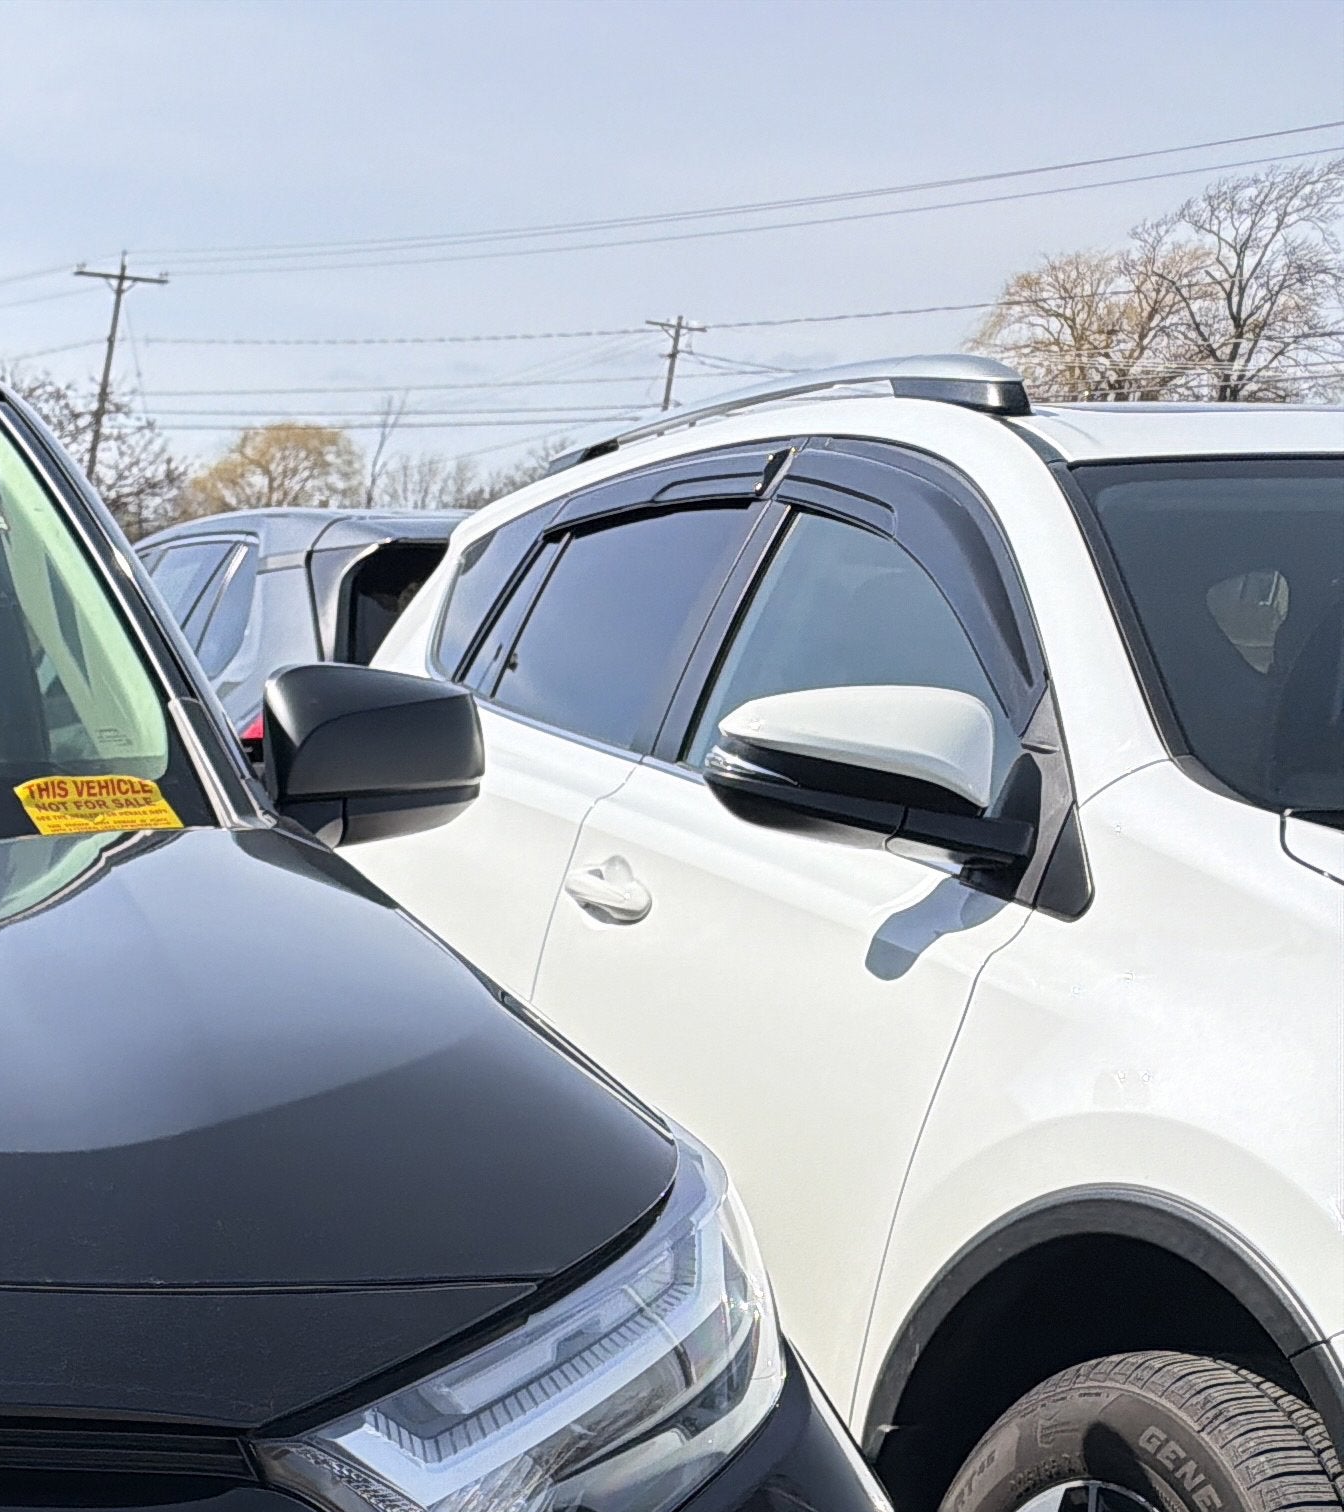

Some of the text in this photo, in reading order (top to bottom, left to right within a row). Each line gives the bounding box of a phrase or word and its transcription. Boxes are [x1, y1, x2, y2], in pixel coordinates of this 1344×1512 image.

[26, 778, 154, 800] THIS VEHICLE
[35, 797, 157, 813] NOT FOR SALE
